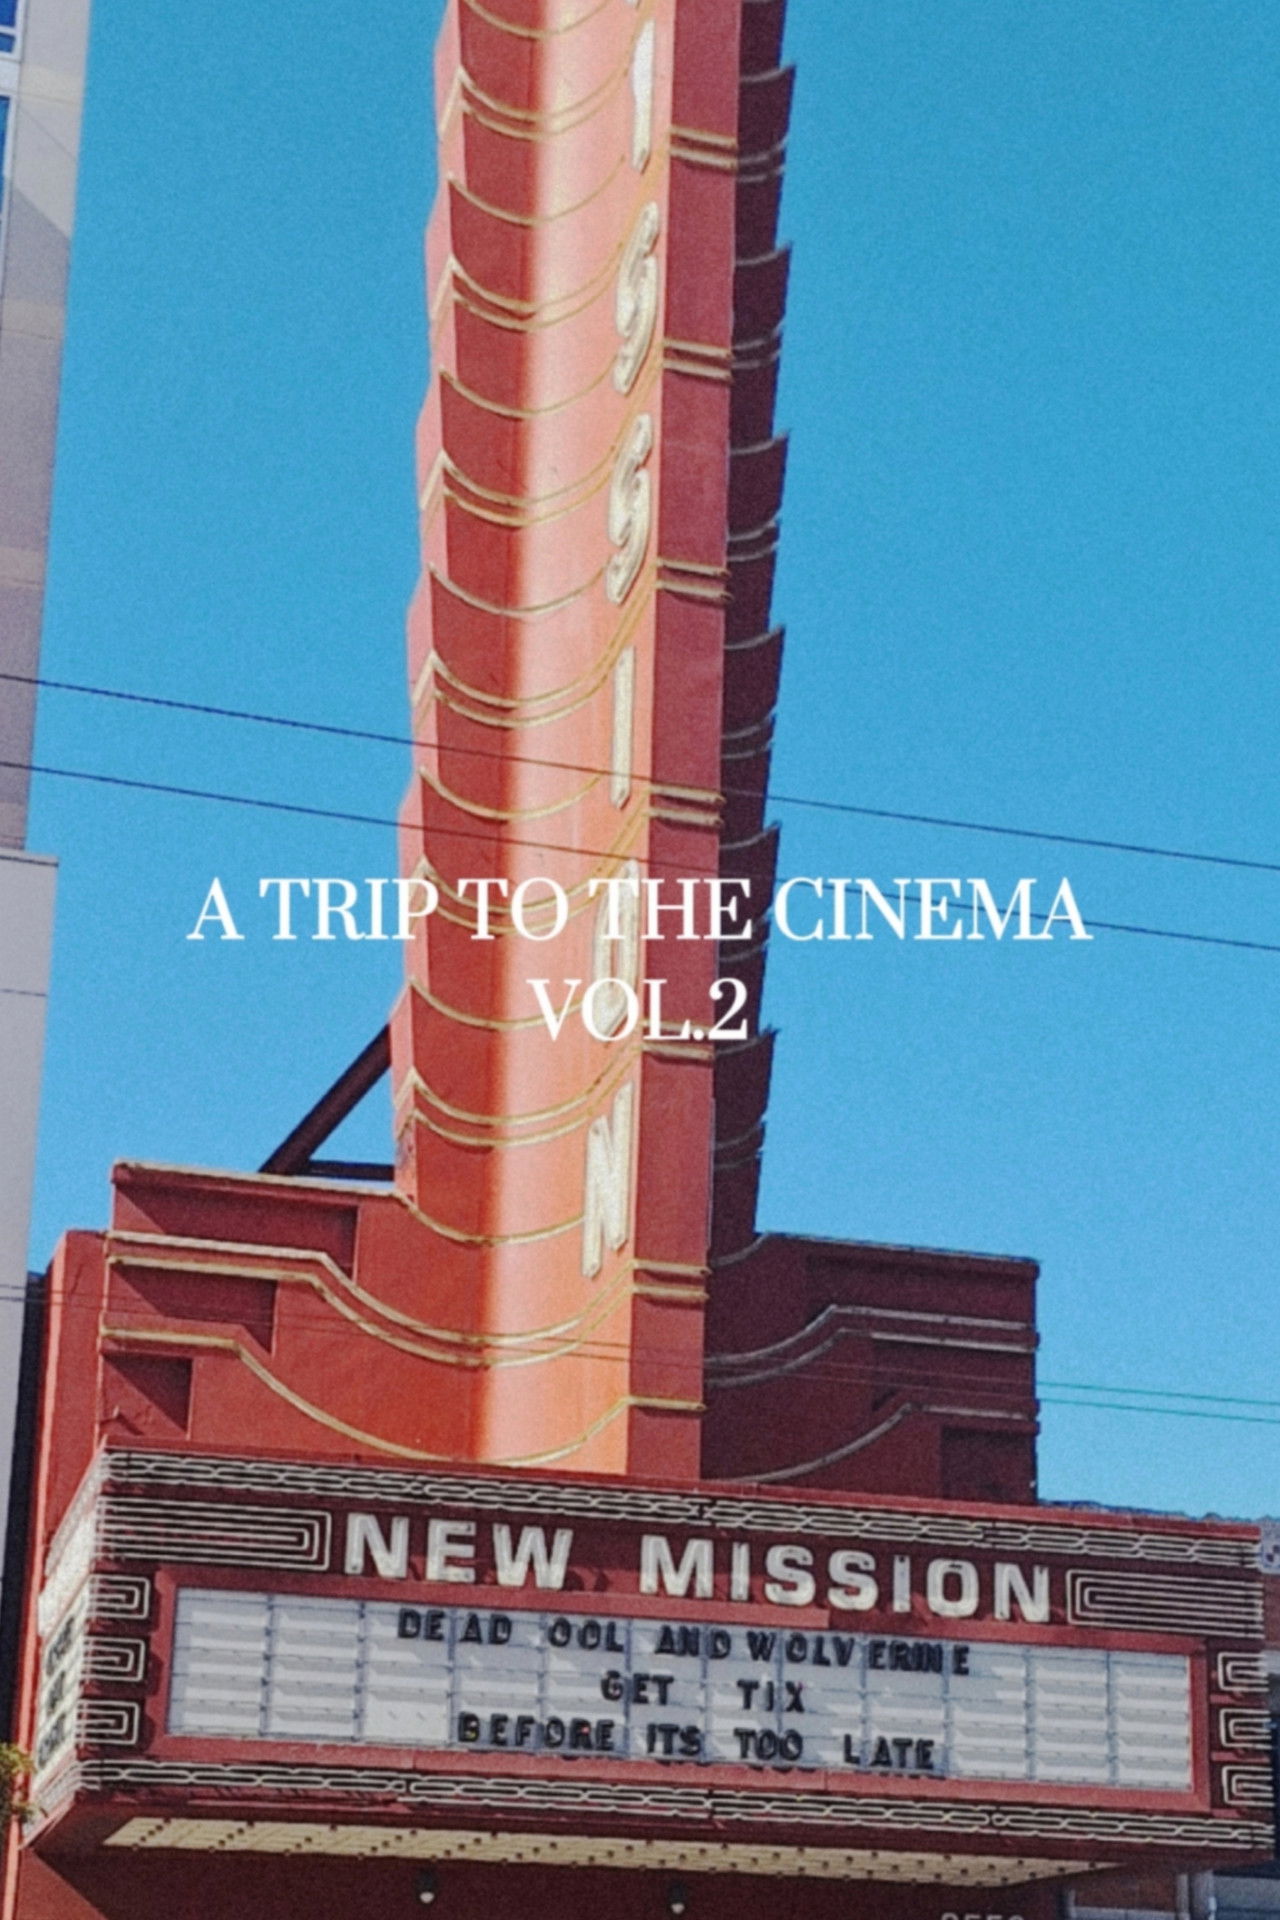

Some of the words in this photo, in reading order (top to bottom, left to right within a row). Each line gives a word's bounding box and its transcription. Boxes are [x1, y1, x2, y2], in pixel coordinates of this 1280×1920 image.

[582, 0, 659, 1278] ISSION
[343, 1511, 574, 1590] NEW
[639, 1533, 1051, 1624] MISSION
[655, 1624, 731, 1660] AND
[746, 1631, 970, 1675] WOLVERINE
[601, 1669, 674, 1705] GET
[737, 1678, 805, 1713] TIX
[457, 1710, 616, 1751] BEFORE
[646, 1722, 701, 1756] ITS
[734, 1728, 803, 1762] TOO
[843, 1734, 934, 1770] LATE
